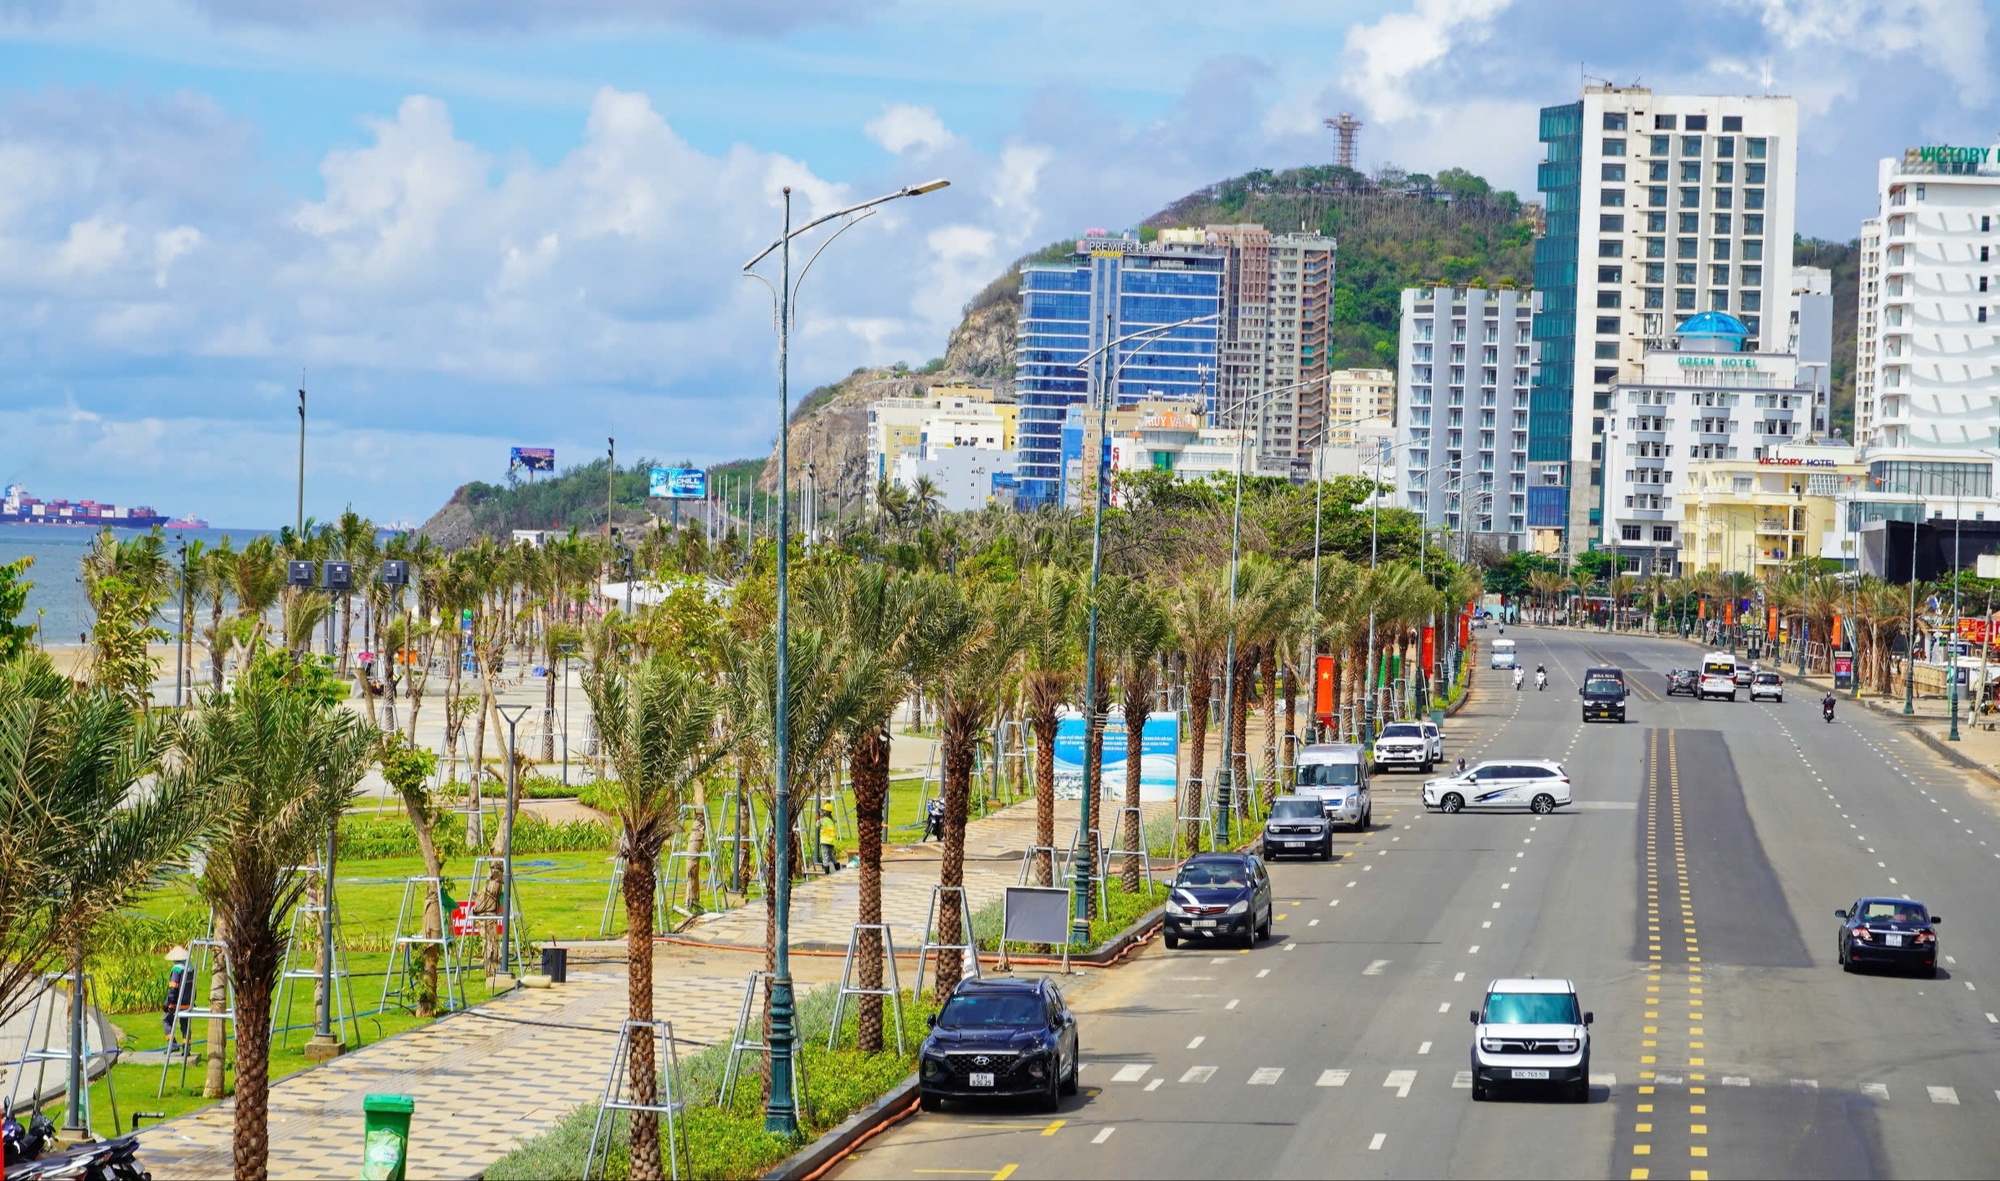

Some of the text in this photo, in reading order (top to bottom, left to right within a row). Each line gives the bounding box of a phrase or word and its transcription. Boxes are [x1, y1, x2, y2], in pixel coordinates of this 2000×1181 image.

[1920, 146, 1991, 164] VICTORY
[1089, 241, 1133, 253] PREMIER
[1677, 357, 1758, 368] GREEN HOTEL
[1758, 457, 1837, 468] VICTORY HOTEL
